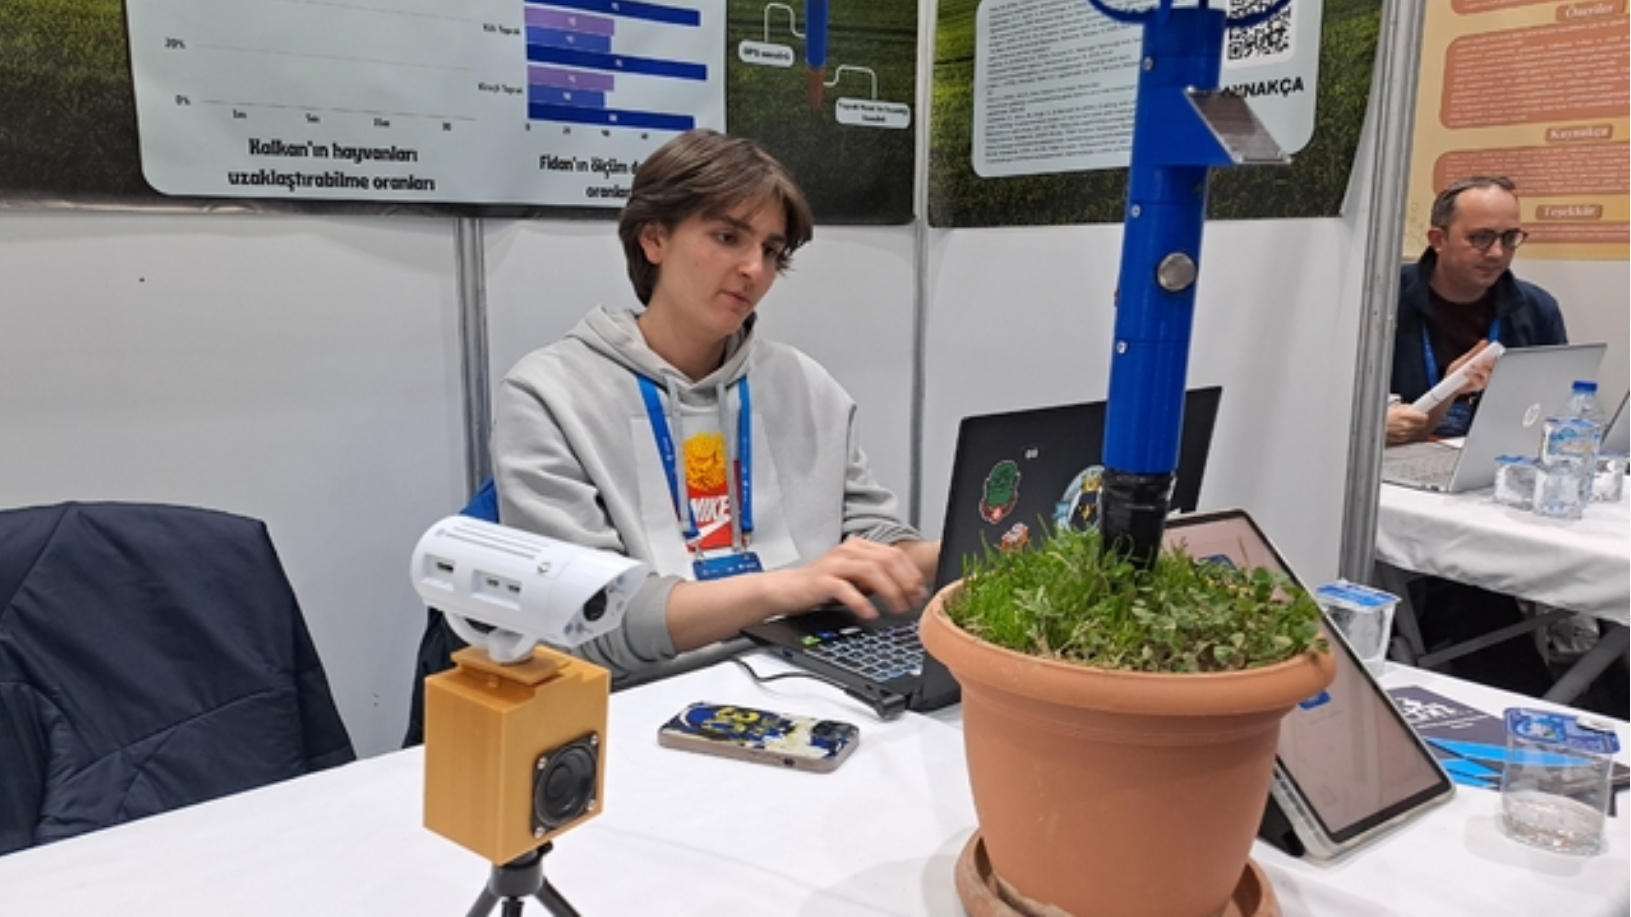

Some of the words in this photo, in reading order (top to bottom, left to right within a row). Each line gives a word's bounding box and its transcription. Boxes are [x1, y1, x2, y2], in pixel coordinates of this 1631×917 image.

[1221, 76, 1304, 98] AYNAKÇA
[249, 138, 329, 158] Kalkan'ın
[332, 142, 418, 164] hayvanları
[228, 169, 370, 192] uzaklaştırabilme
[372, 174, 436, 191] oranları
